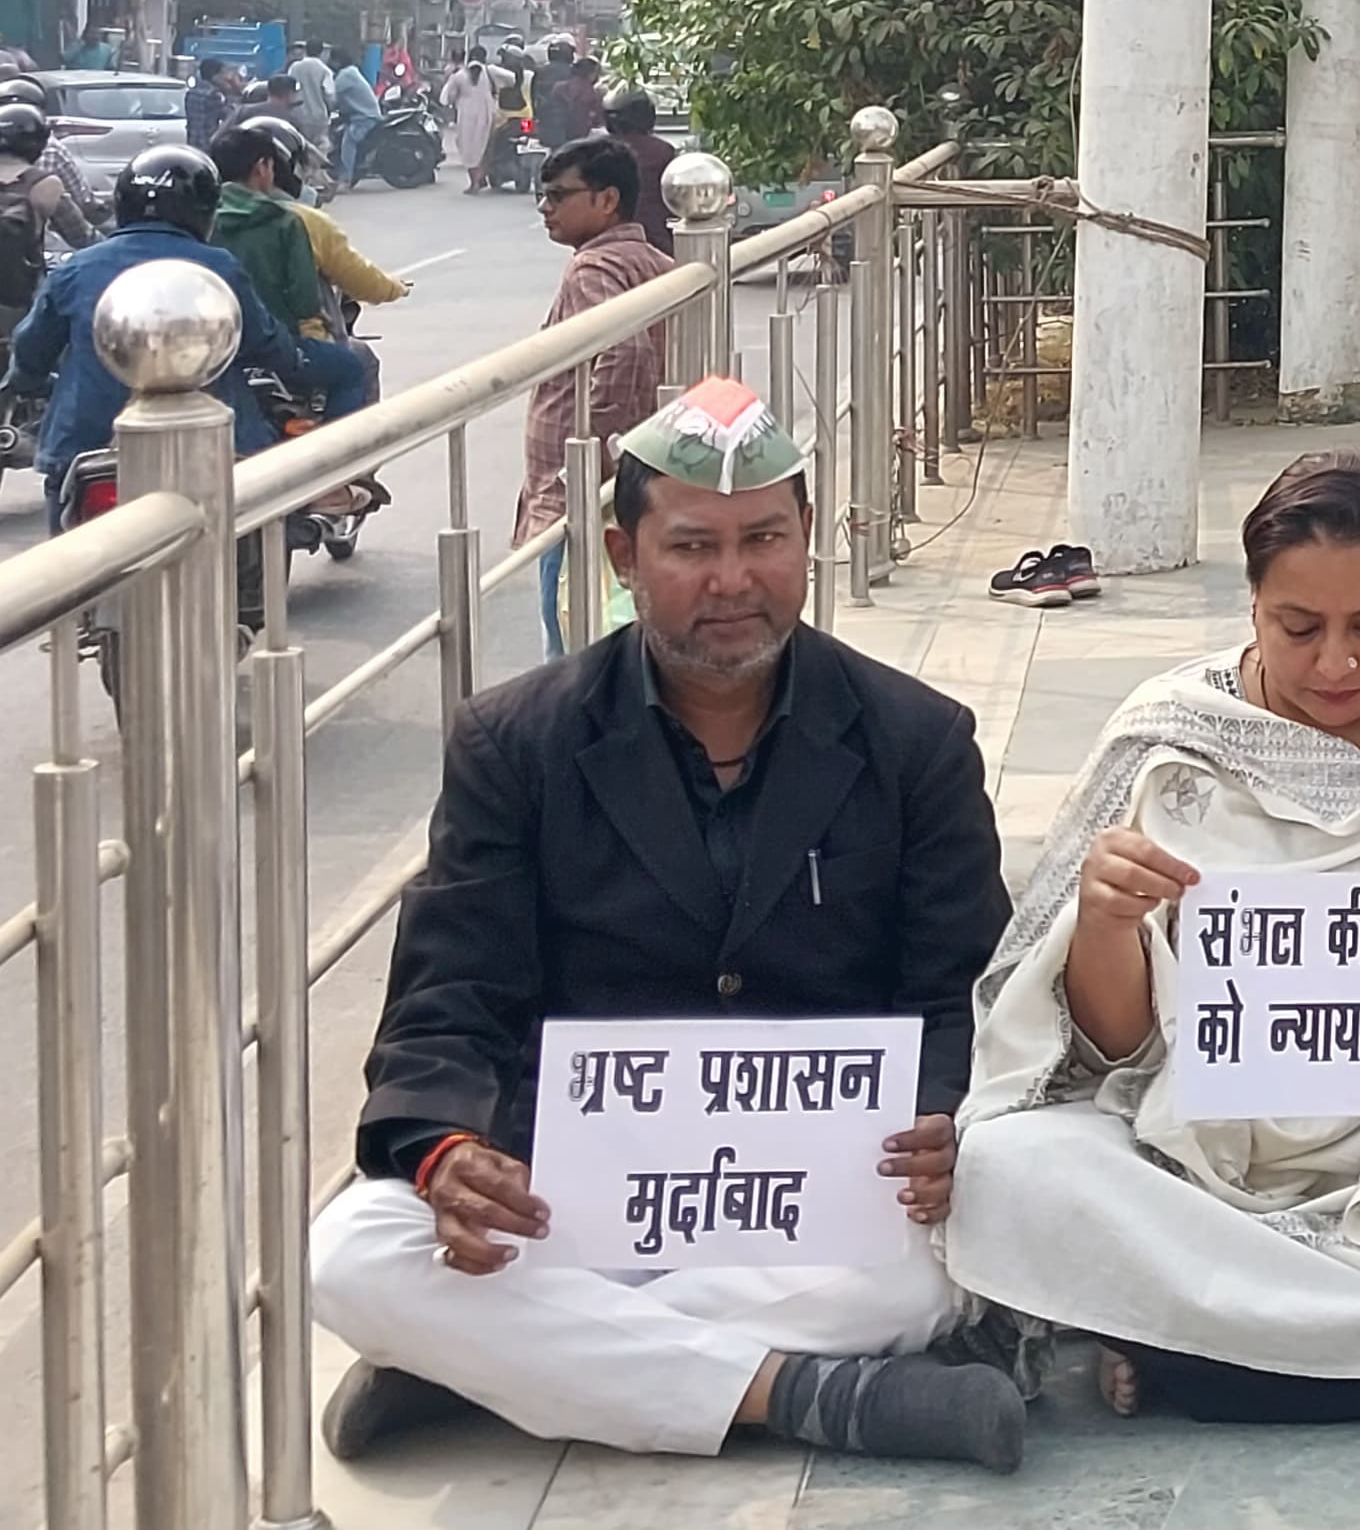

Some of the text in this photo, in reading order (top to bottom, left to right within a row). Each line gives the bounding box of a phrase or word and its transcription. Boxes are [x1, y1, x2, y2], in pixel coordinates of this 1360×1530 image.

[1198, 888, 1305, 967] संभल
[1197, 977, 1244, 1065] को
[568, 1047, 887, 1118] भ्रष्ट प्रशासन
[625, 1145, 808, 1255] मुर्दाबाद
